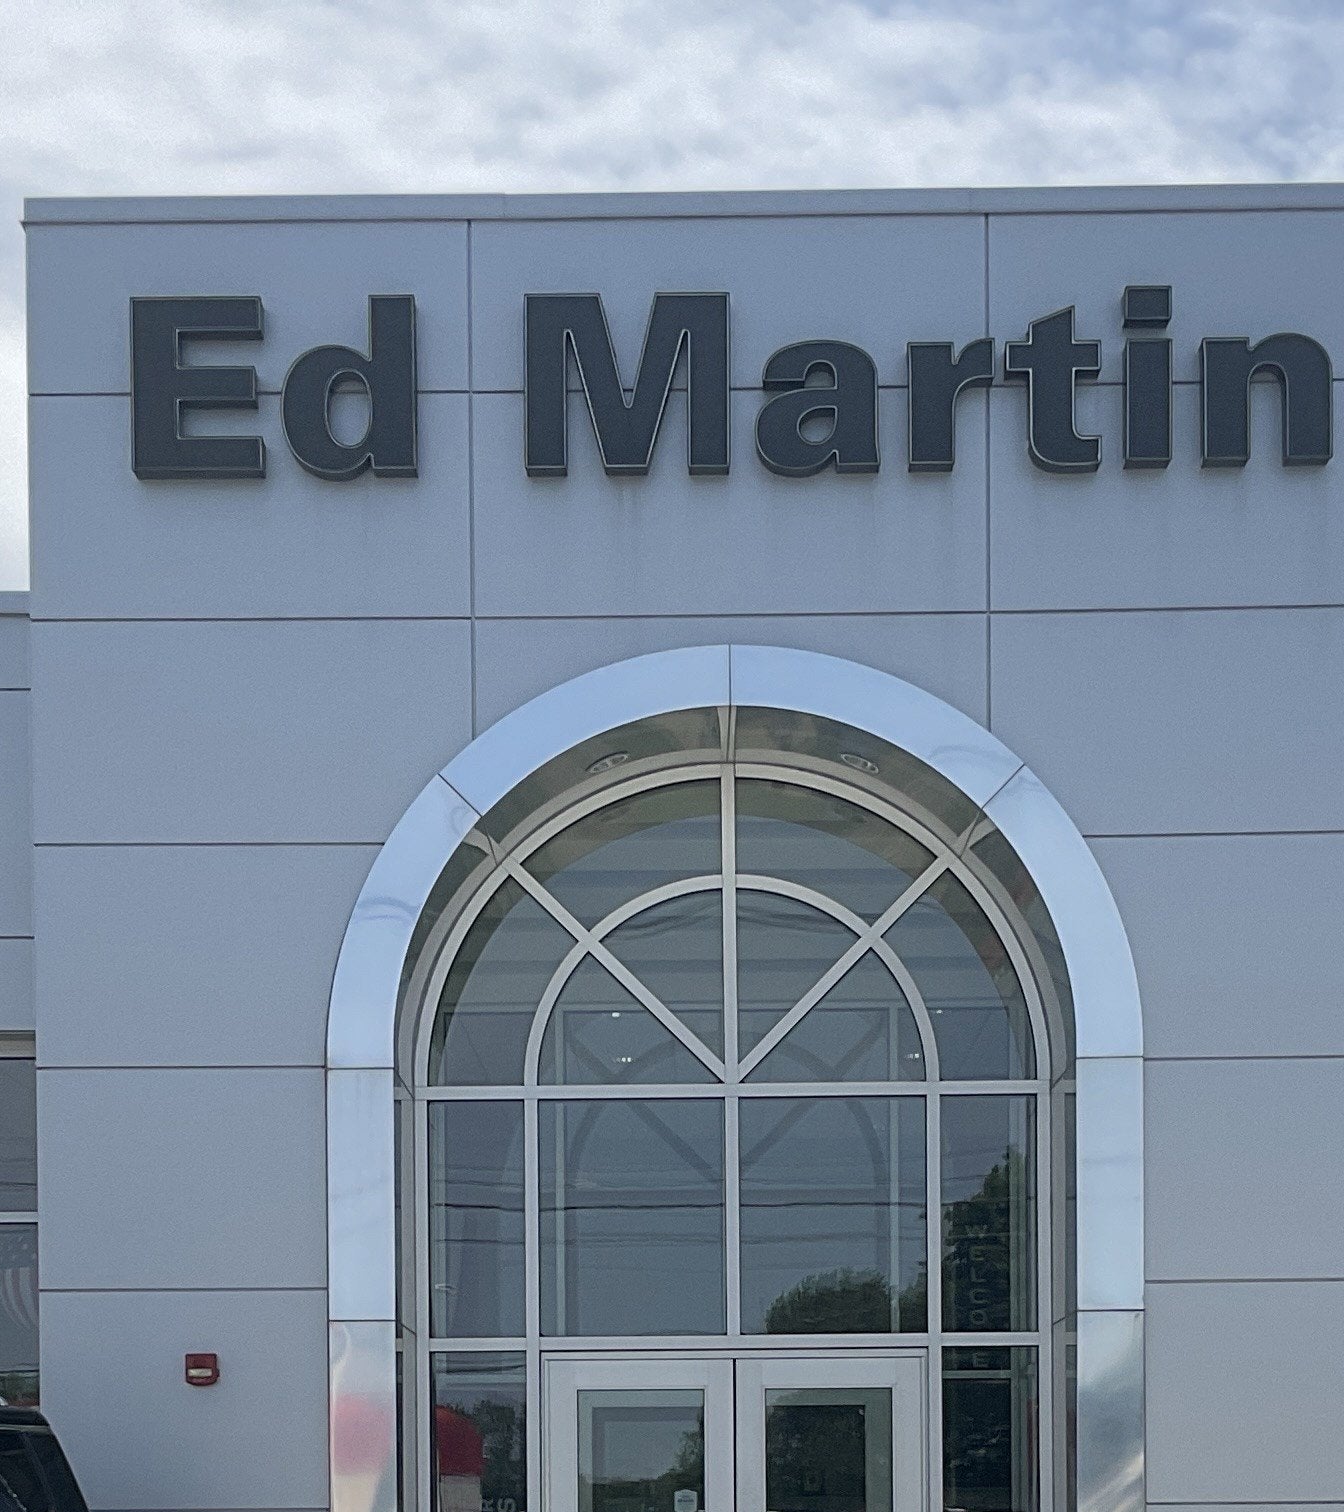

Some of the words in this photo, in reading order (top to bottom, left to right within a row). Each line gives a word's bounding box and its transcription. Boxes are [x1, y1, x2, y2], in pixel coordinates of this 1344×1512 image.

[129, 293, 420, 483] Ed
[523, 285, 1335, 481] Martin
[965, 1224, 990, 1368] WELCOE
